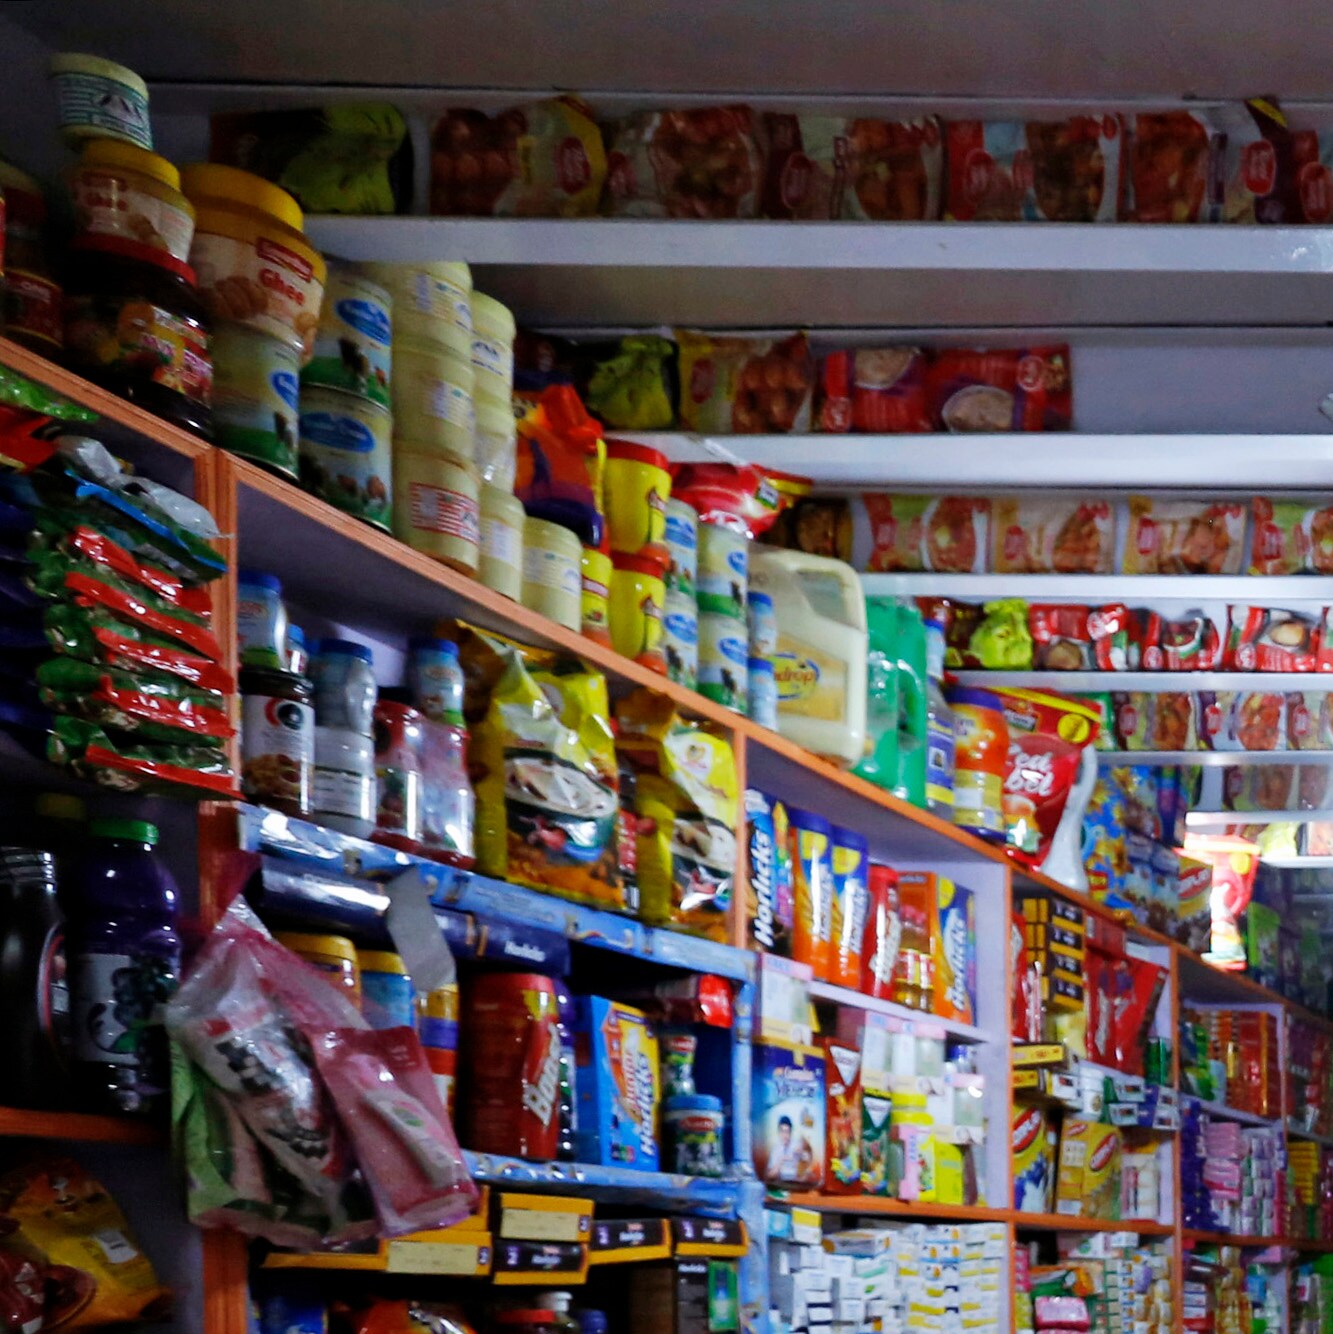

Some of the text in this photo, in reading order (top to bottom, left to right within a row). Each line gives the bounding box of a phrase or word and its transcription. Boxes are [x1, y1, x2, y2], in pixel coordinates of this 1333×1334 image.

[259, 268, 305, 305] Ghee
[750, 829, 777, 947] Horlicks
[634, 1050, 656, 1156] Horlicks
